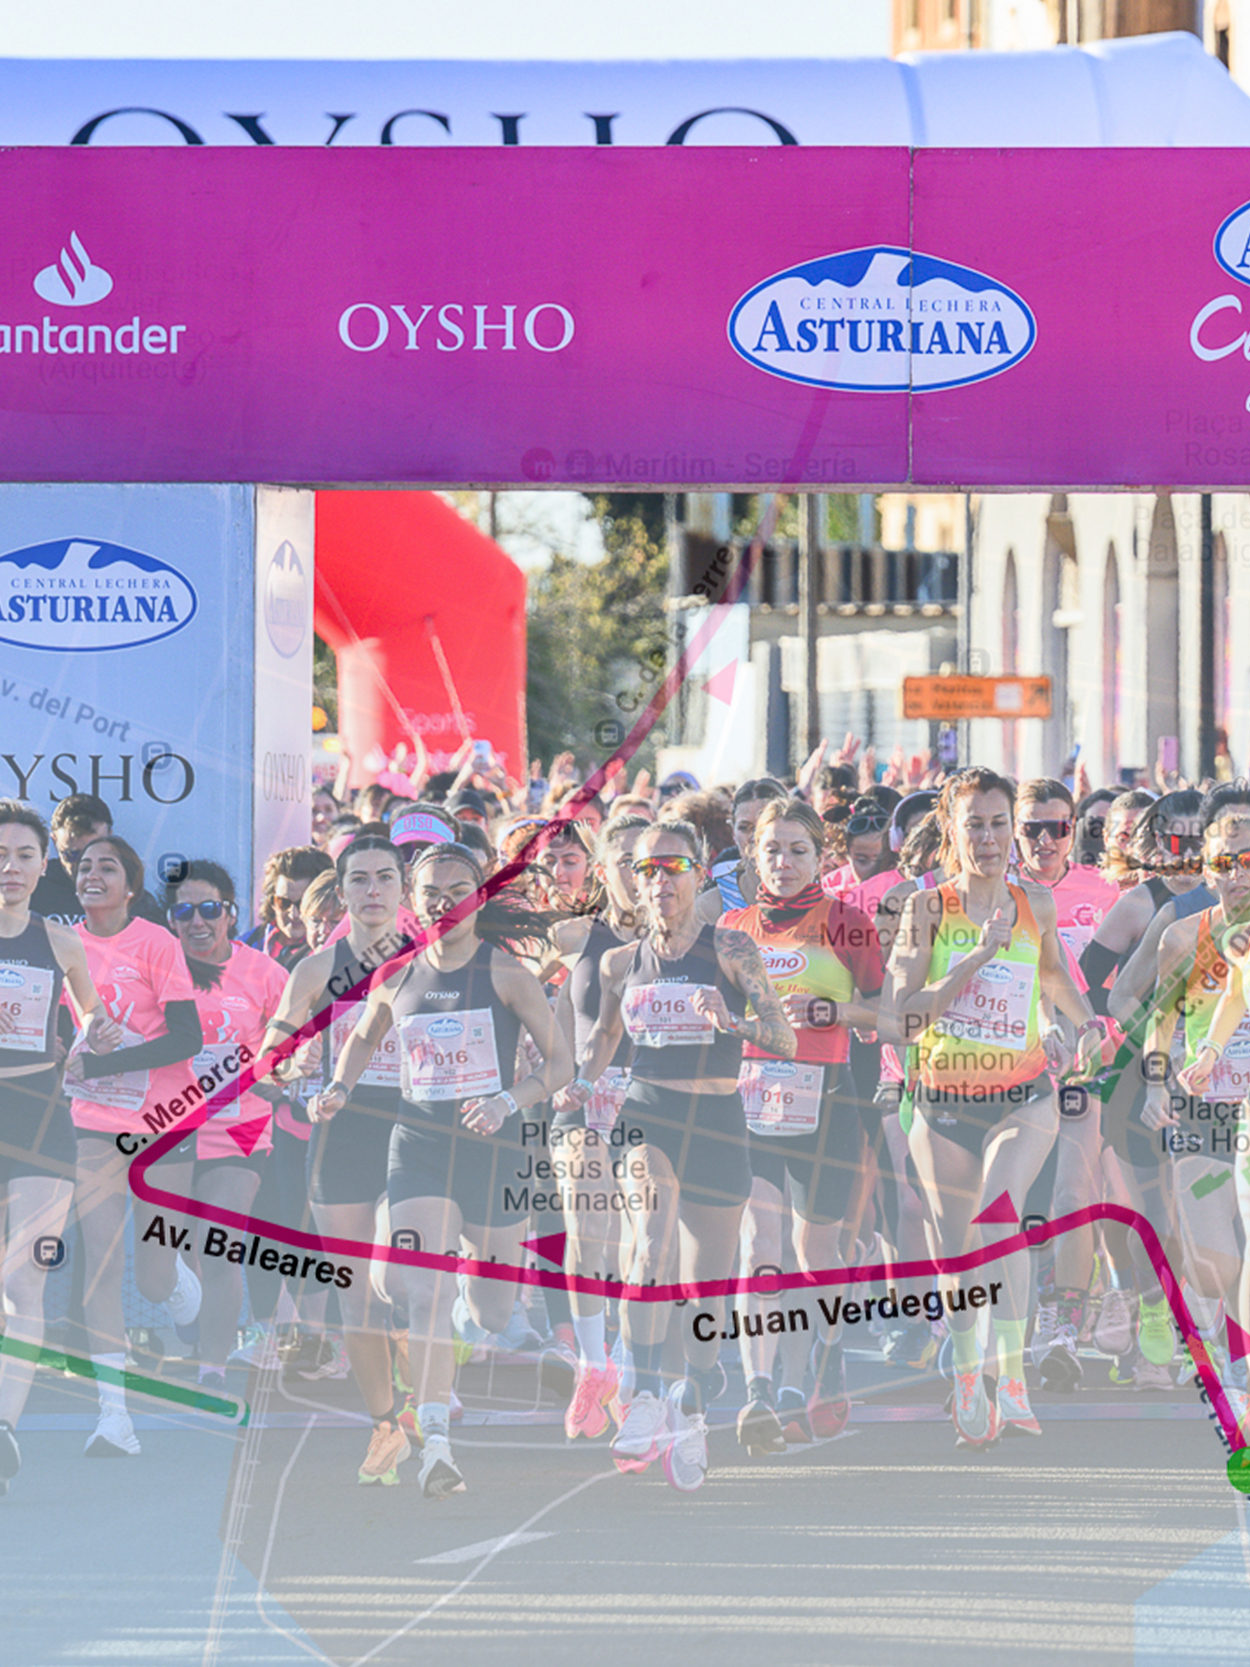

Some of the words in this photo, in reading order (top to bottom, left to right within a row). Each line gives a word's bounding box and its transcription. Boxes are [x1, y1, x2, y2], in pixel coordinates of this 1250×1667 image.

[800, 296, 895, 311] CENTRAL
[905, 297, 1004, 313] LECHERA
[0, 316, 187, 354] antander
[338, 302, 576, 352] OYSHO
[752, 299, 1012, 355] ASTURIANA
[11, 578, 87, 589] CENTRAL
[94, 578, 172, 589] LECHERA
[0, 752, 195, 803] YSHO
[651, 1000, 686, 1014] 016
[975, 994, 1009, 1013] 016
[376, 1040, 396, 1053] 16
[434, 1050, 468, 1066] 016
[761, 1089, 794, 1105] 016
